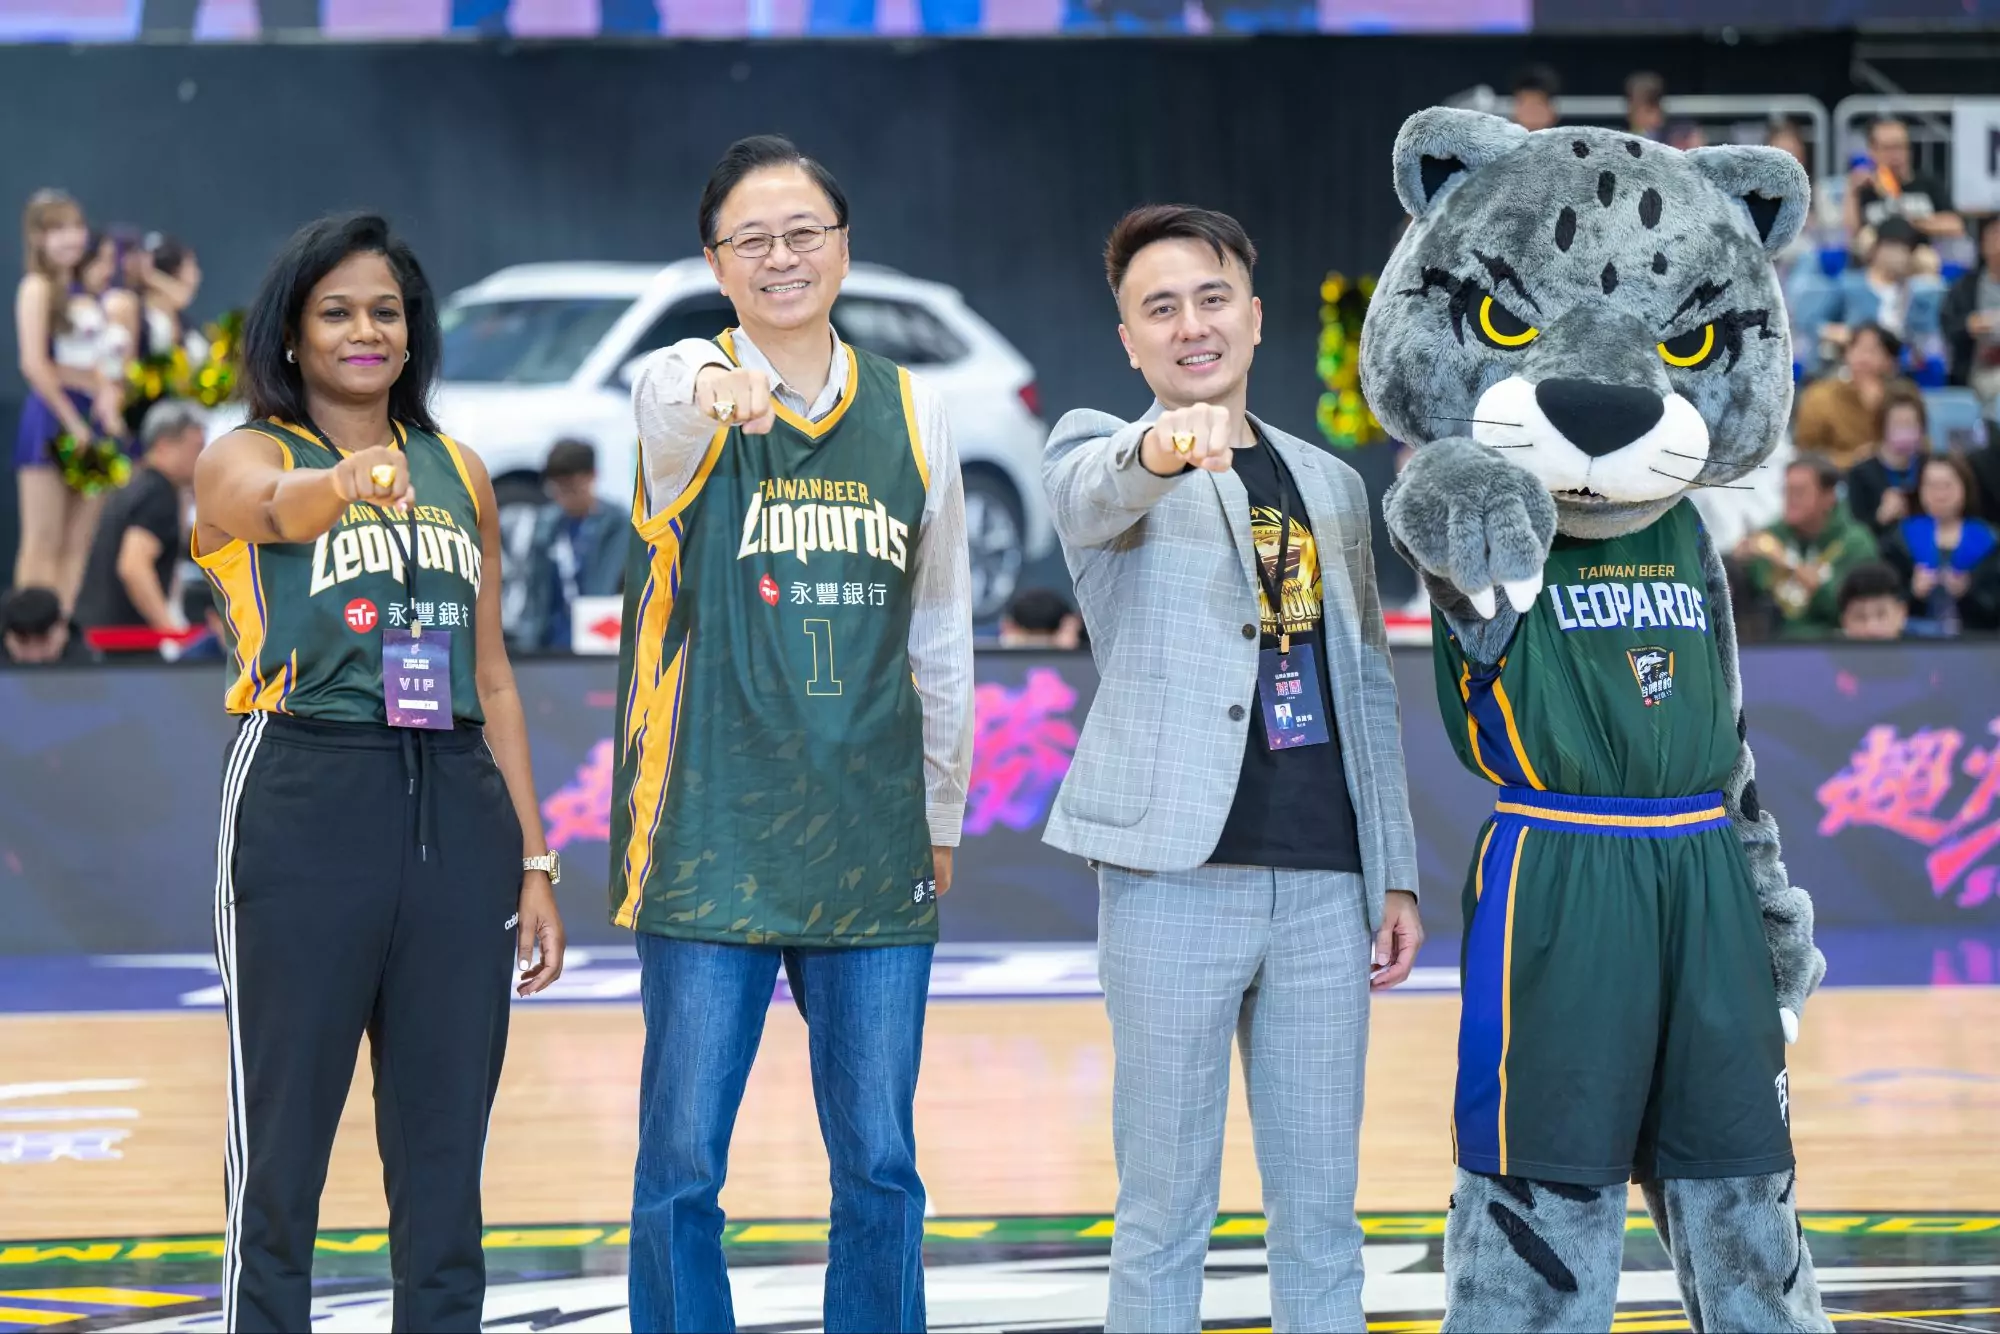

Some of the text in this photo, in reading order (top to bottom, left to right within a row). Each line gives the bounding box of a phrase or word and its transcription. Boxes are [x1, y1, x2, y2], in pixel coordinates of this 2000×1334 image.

[824, 480, 870, 505] BEER
[1577, 564, 1675, 580] TAIWAN BEER
[790, 581, 888, 606] 永豐銀行
[1547, 582, 1708, 633] LEOPARDS
[804, 618, 843, 696] 1
[399, 677, 435, 692] VIP
